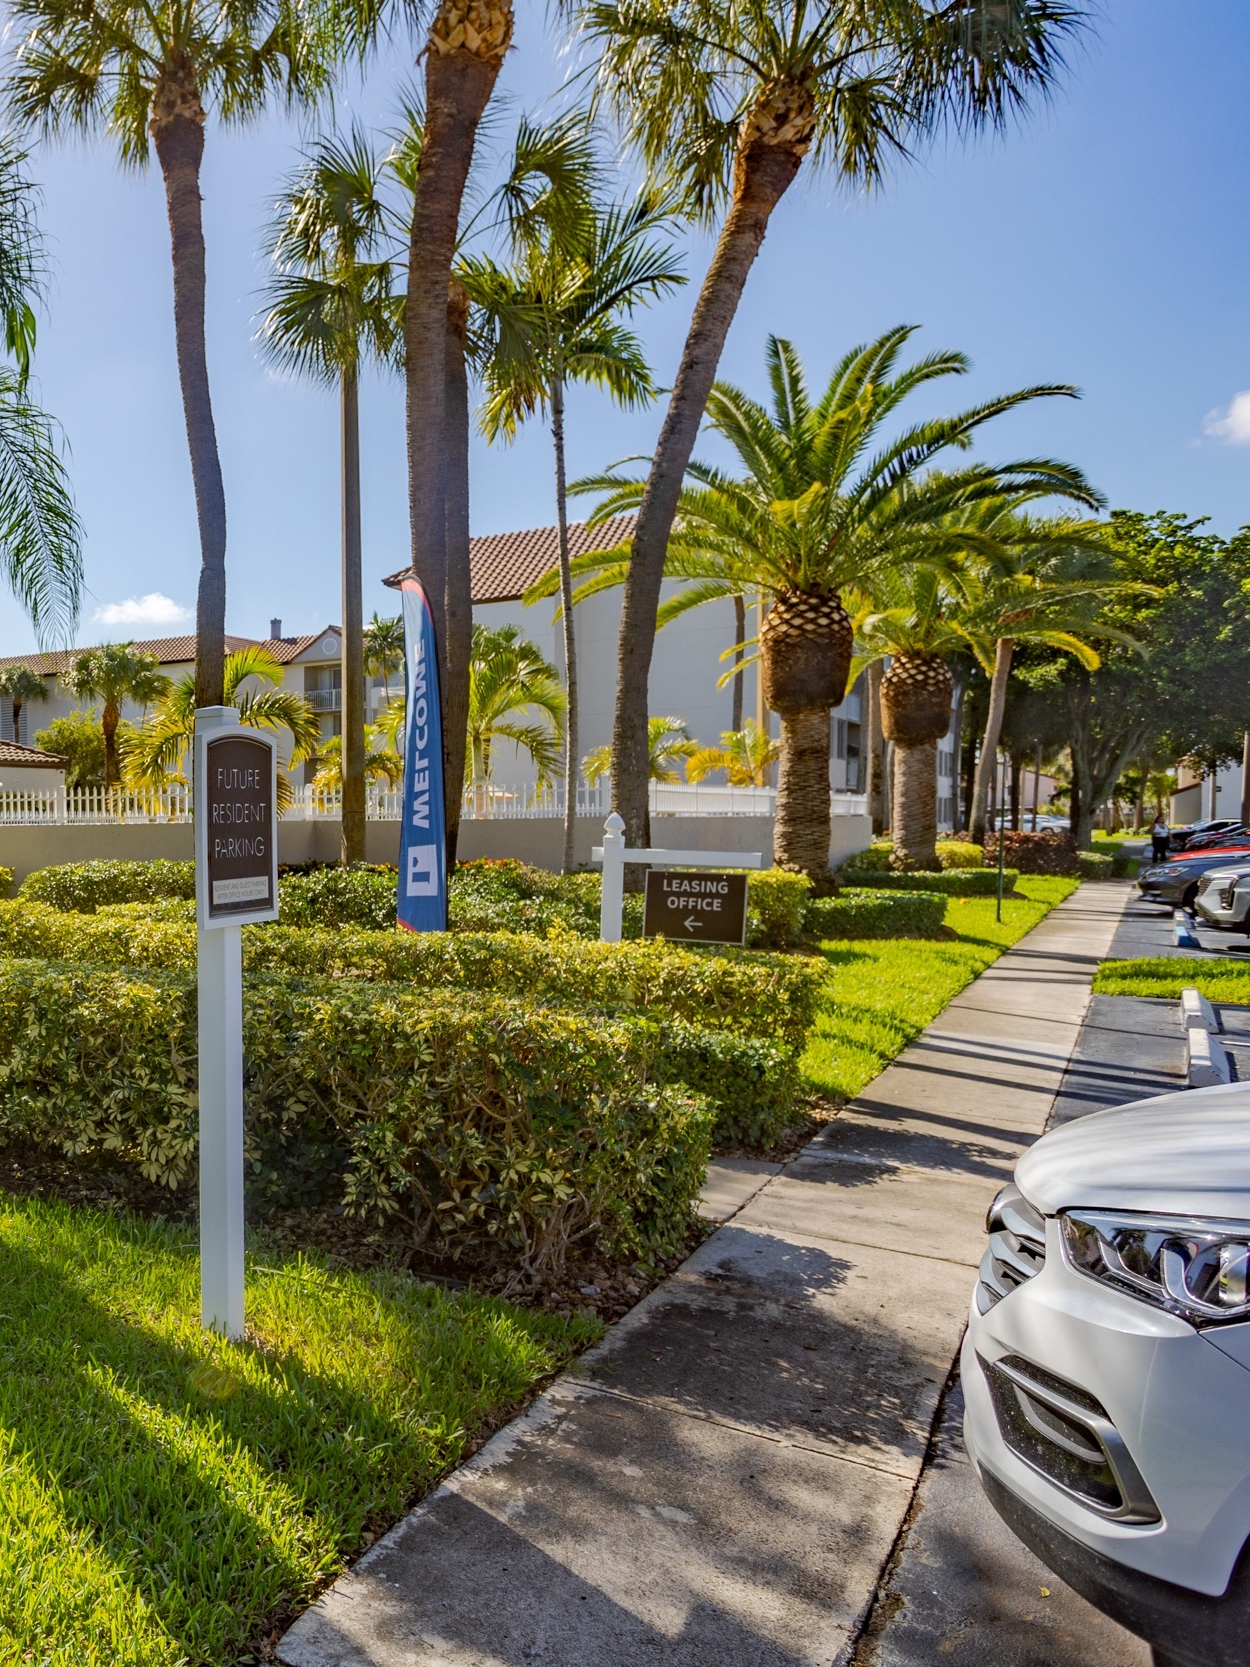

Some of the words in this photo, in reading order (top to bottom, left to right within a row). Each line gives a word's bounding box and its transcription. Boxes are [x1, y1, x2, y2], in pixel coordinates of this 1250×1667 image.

[217, 768, 260, 789] FUTURE
[213, 803, 266, 824] RESIDENT
[215, 836, 265, 859] PARKING
[662, 879, 729, 894] LEASING
[667, 896, 722, 911] OFFICE
